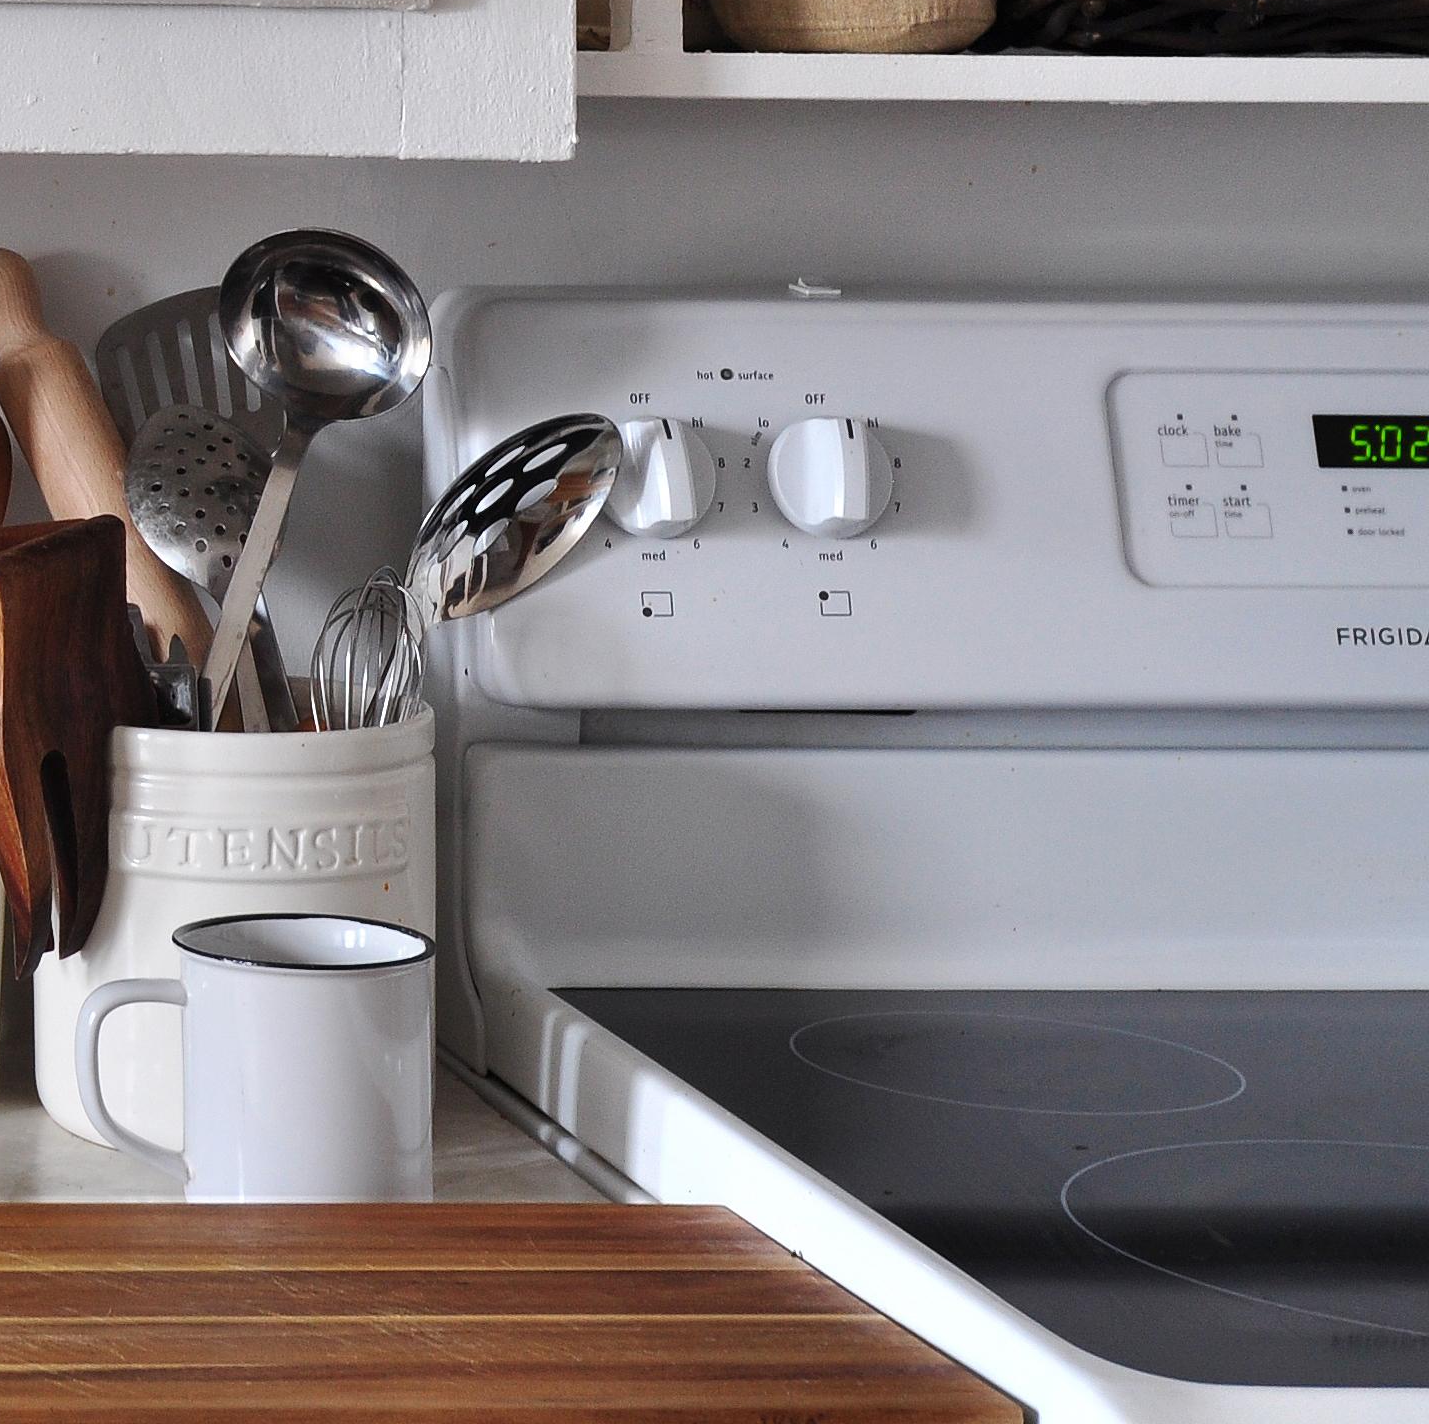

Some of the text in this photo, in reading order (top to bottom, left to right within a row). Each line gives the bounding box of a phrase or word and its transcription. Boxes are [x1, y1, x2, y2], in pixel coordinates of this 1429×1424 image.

[696, 370, 714, 380] hot
[737, 370, 774, 381] surface
[629, 393, 651, 404] OFF
[805, 393, 826, 404] OFF
[692, 417, 703, 428] hi
[758, 417, 769, 428] lo
[867, 418, 879, 428] hi
[1157, 424, 1188, 436] clock
[1213, 424, 1241, 436] bake
[718, 457, 725, 468] 8
[743, 458, 751, 468] 2
[894, 457, 902, 468] 8
[1167, 494, 1199, 507] timer
[1223, 496, 1251, 507] start
[718, 502, 724, 512] 7
[752, 502, 759, 513] 3
[894, 502, 901, 513] 7
[604, 538, 612, 549] 4
[693, 538, 701, 549] 6
[782, 538, 789, 549] 4
[870, 538, 877, 549] 6
[641, 550, 666, 561] med
[819, 550, 843, 561] med
[121, 823, 408, 872] UTENSILS
